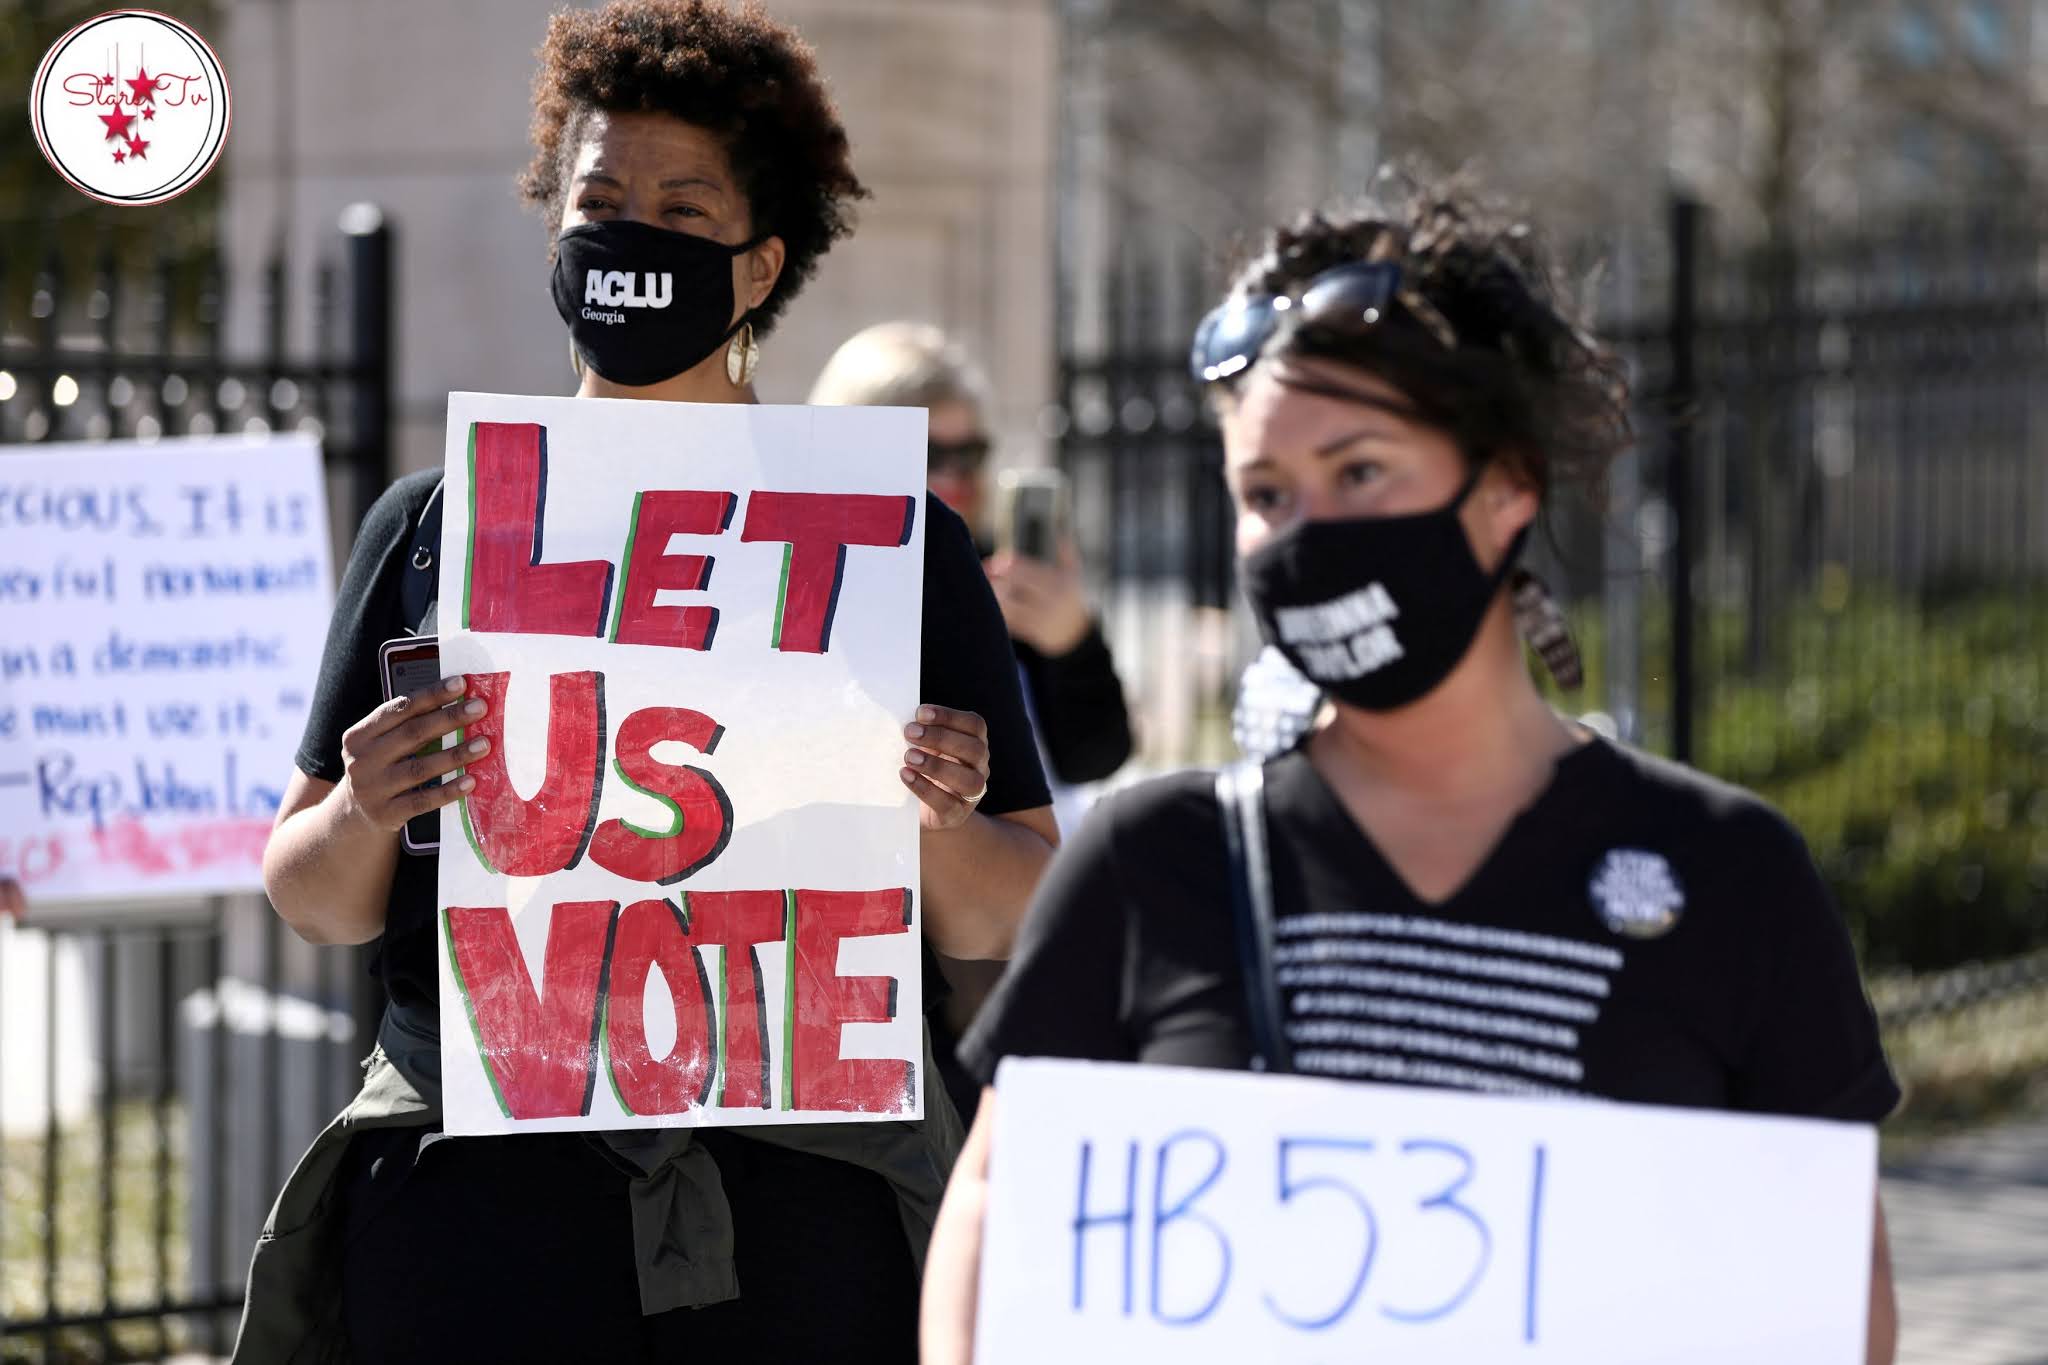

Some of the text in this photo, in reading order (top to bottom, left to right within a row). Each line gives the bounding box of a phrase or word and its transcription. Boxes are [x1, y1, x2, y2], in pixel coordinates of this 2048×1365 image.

[581, 308, 625, 325] Georgia
[584, 269, 673, 308] ACLU
[461, 421, 915, 654] LET
[457, 671, 733, 886] US
[441, 888, 915, 1121] VOTE
[1072, 1127, 1547, 1343] HB 531
